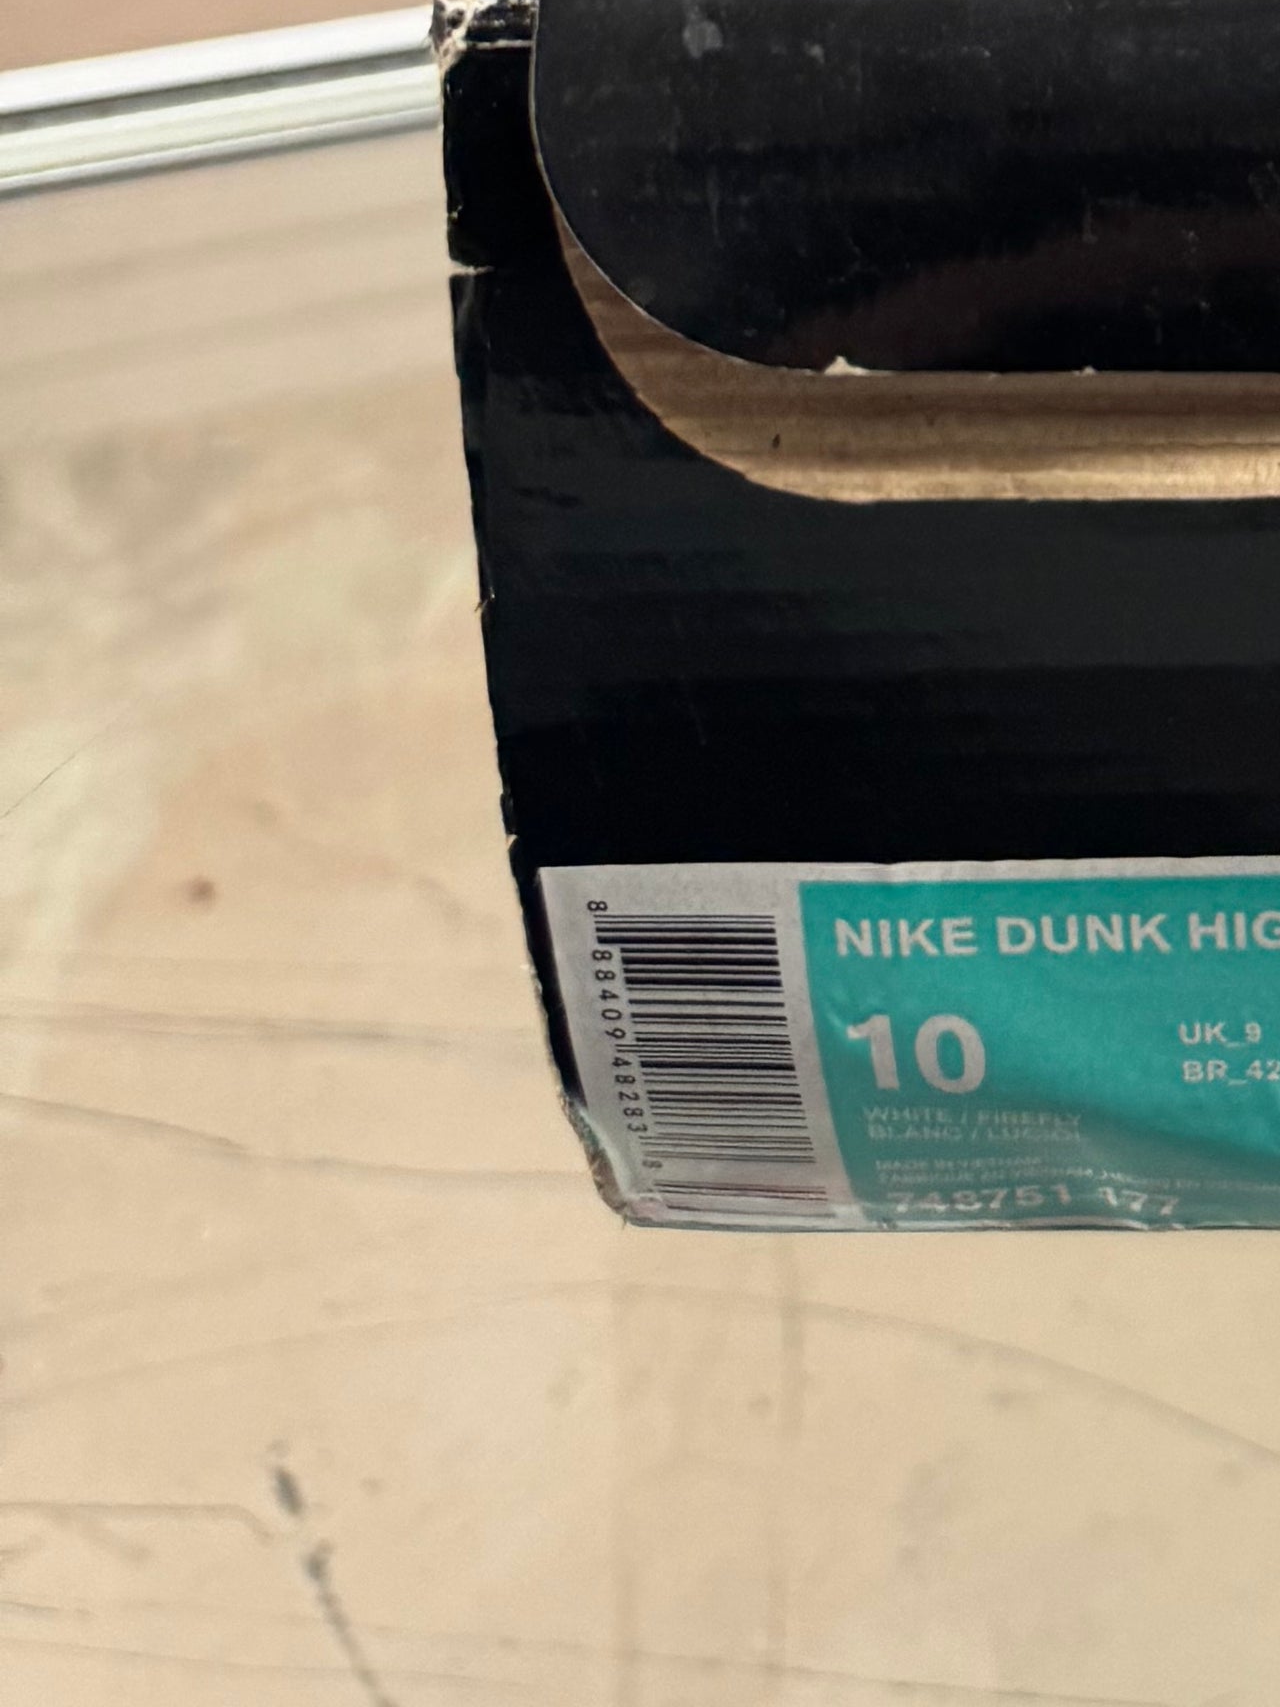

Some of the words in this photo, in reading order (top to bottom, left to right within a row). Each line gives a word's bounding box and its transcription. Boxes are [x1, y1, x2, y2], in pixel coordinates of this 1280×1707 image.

[835, 916, 978, 957] NIKE
[996, 913, 1171, 954] DUNK
[592, 949, 626, 1040] 88409
[612, 1055, 649, 1134] 48283
[847, 1014, 986, 1093] 10
